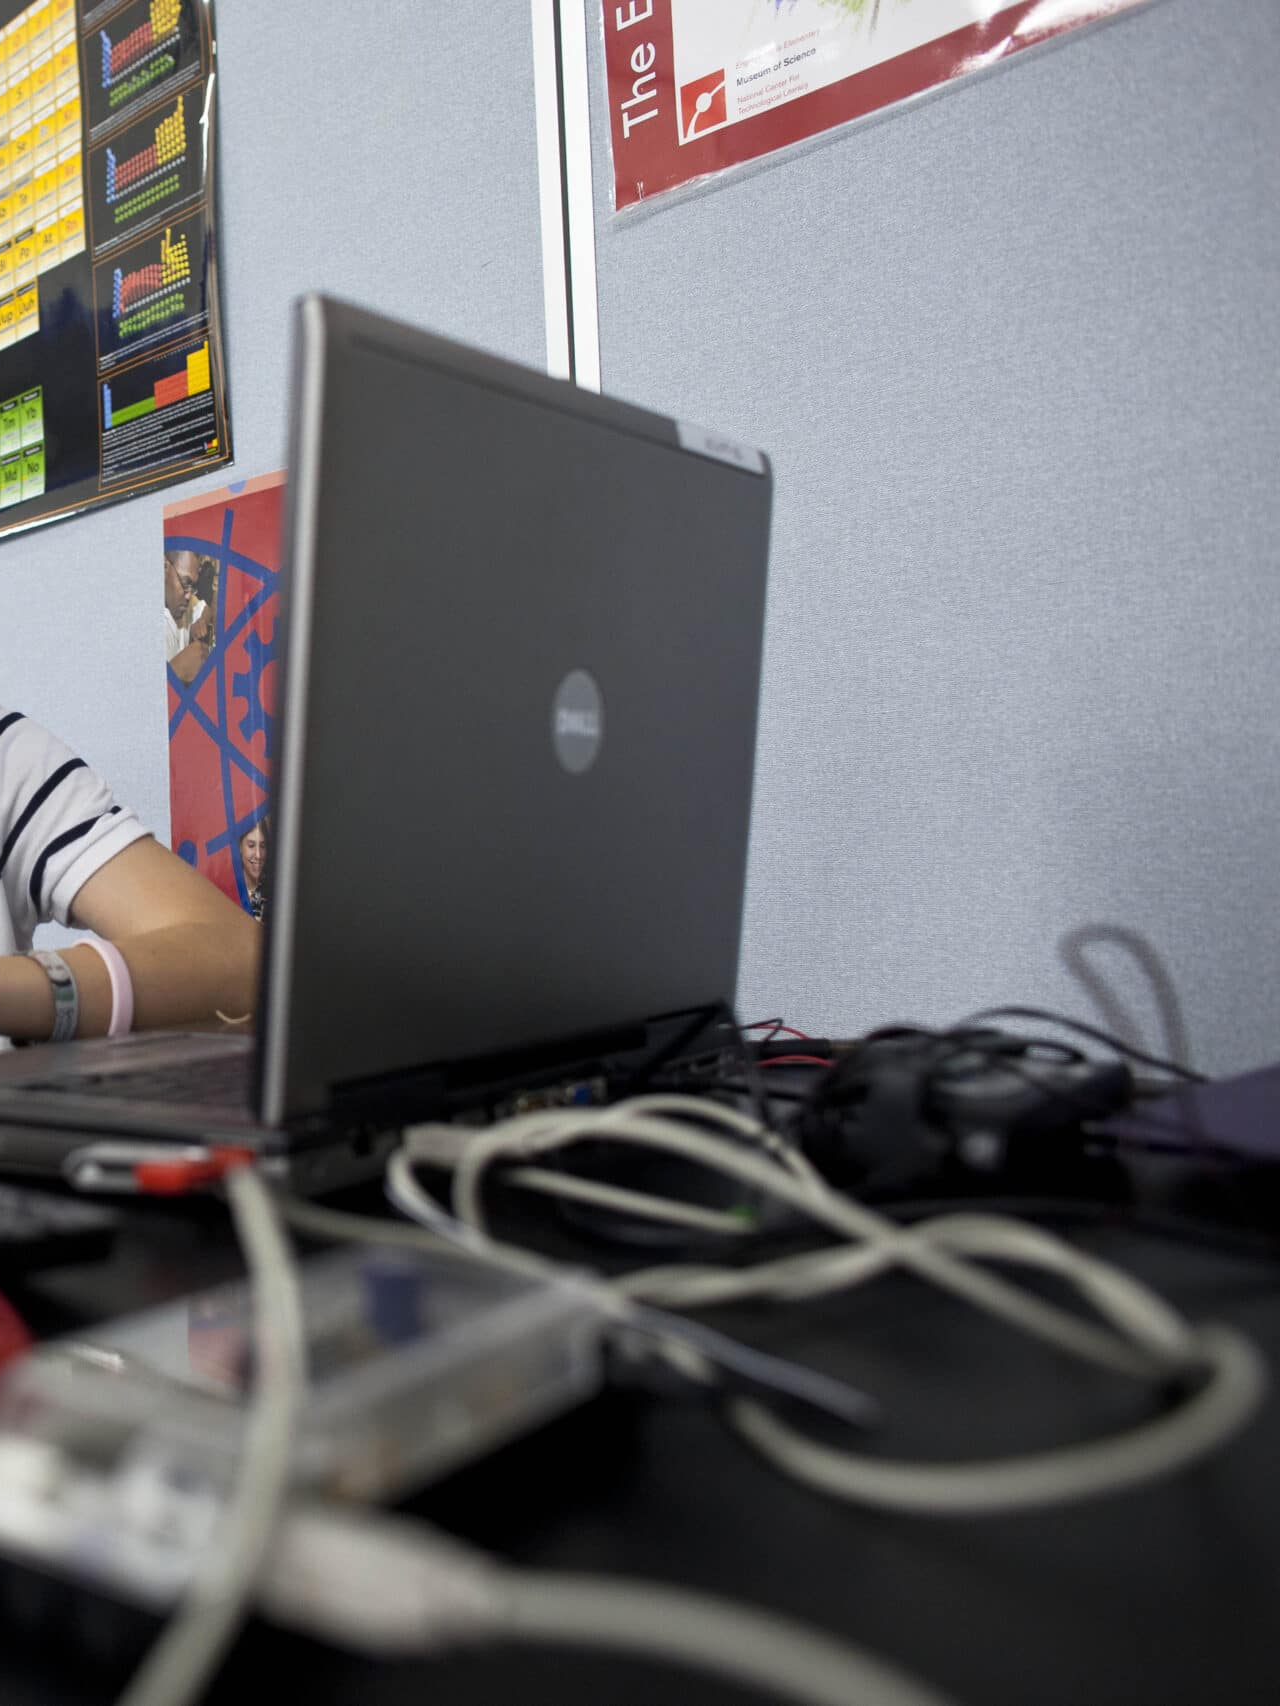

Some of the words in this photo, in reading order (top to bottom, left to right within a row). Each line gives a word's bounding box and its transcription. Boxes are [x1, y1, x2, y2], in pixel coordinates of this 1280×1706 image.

[736, 66, 771, 87] Museum
[773, 60, 783, 71] of
[783, 47, 816, 67] Science
[621, 42, 658, 139] The
[737, 88, 763, 104] National
[738, 94, 782, 114] Technological
